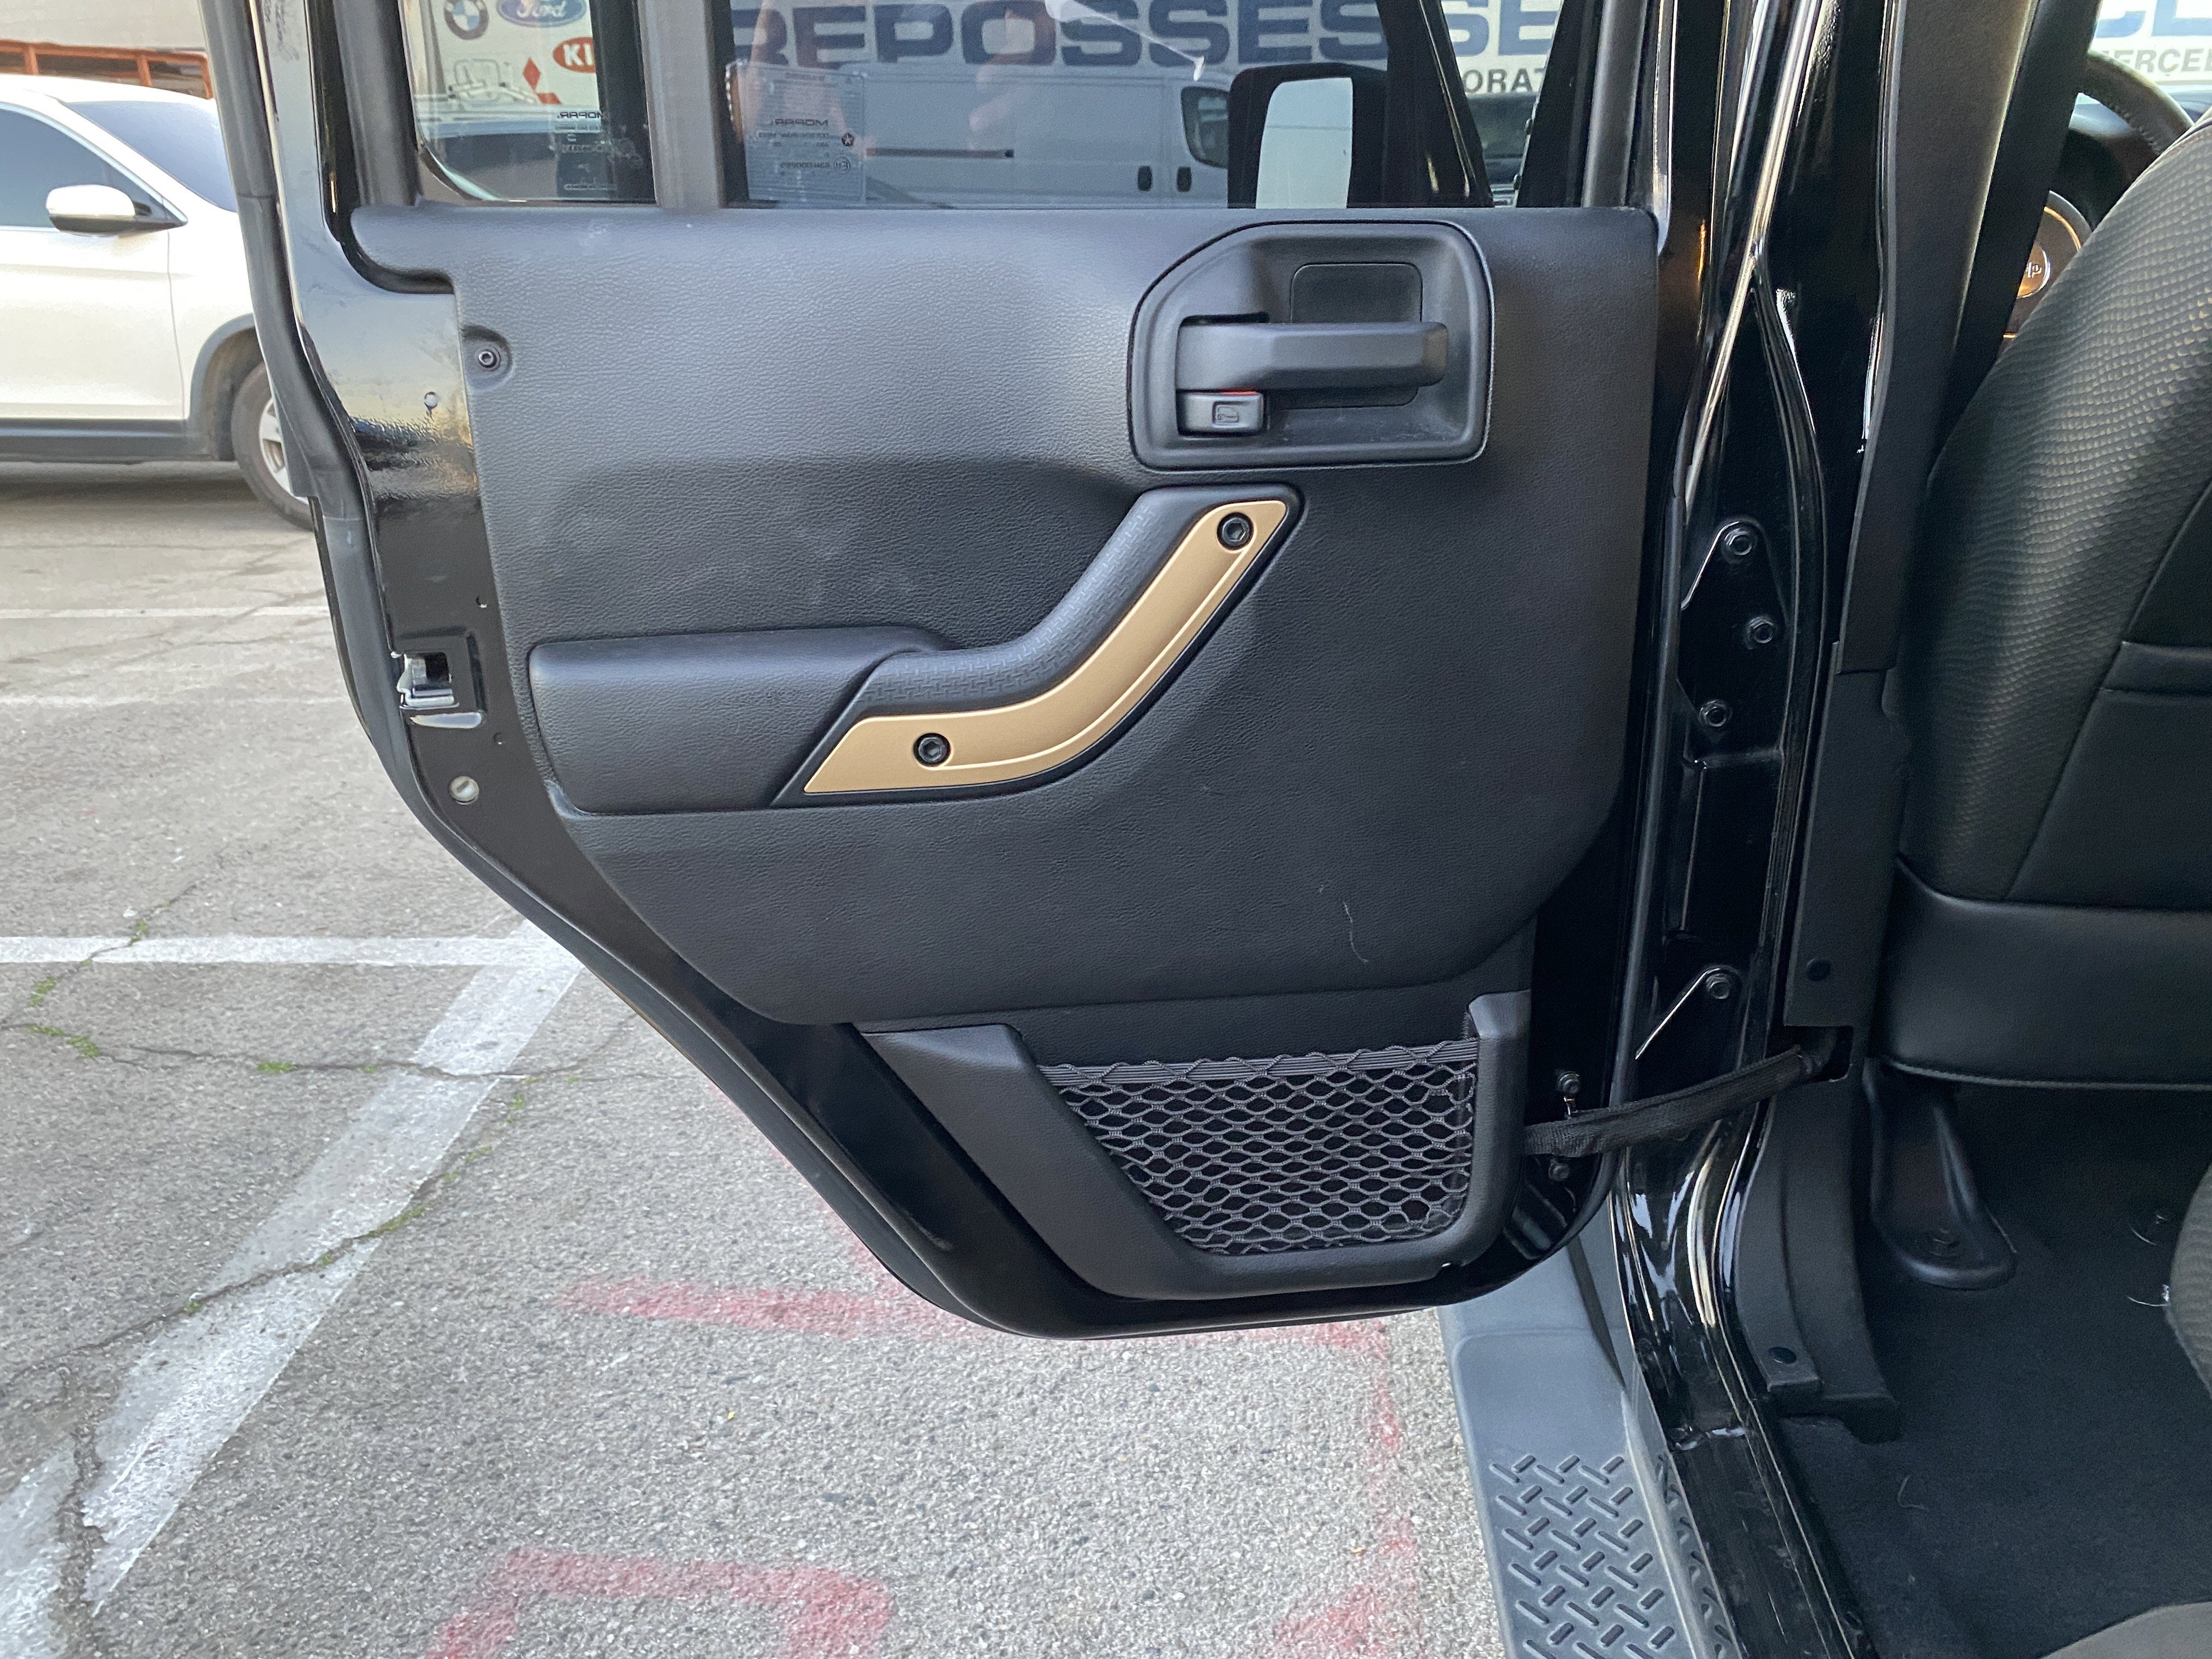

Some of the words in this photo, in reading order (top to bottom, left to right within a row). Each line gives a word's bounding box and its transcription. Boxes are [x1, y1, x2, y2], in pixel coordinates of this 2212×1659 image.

[515, 0, 566, 18] Ford
[563, 43, 594, 66] KI
[1461, 67, 1545, 93] ORA
